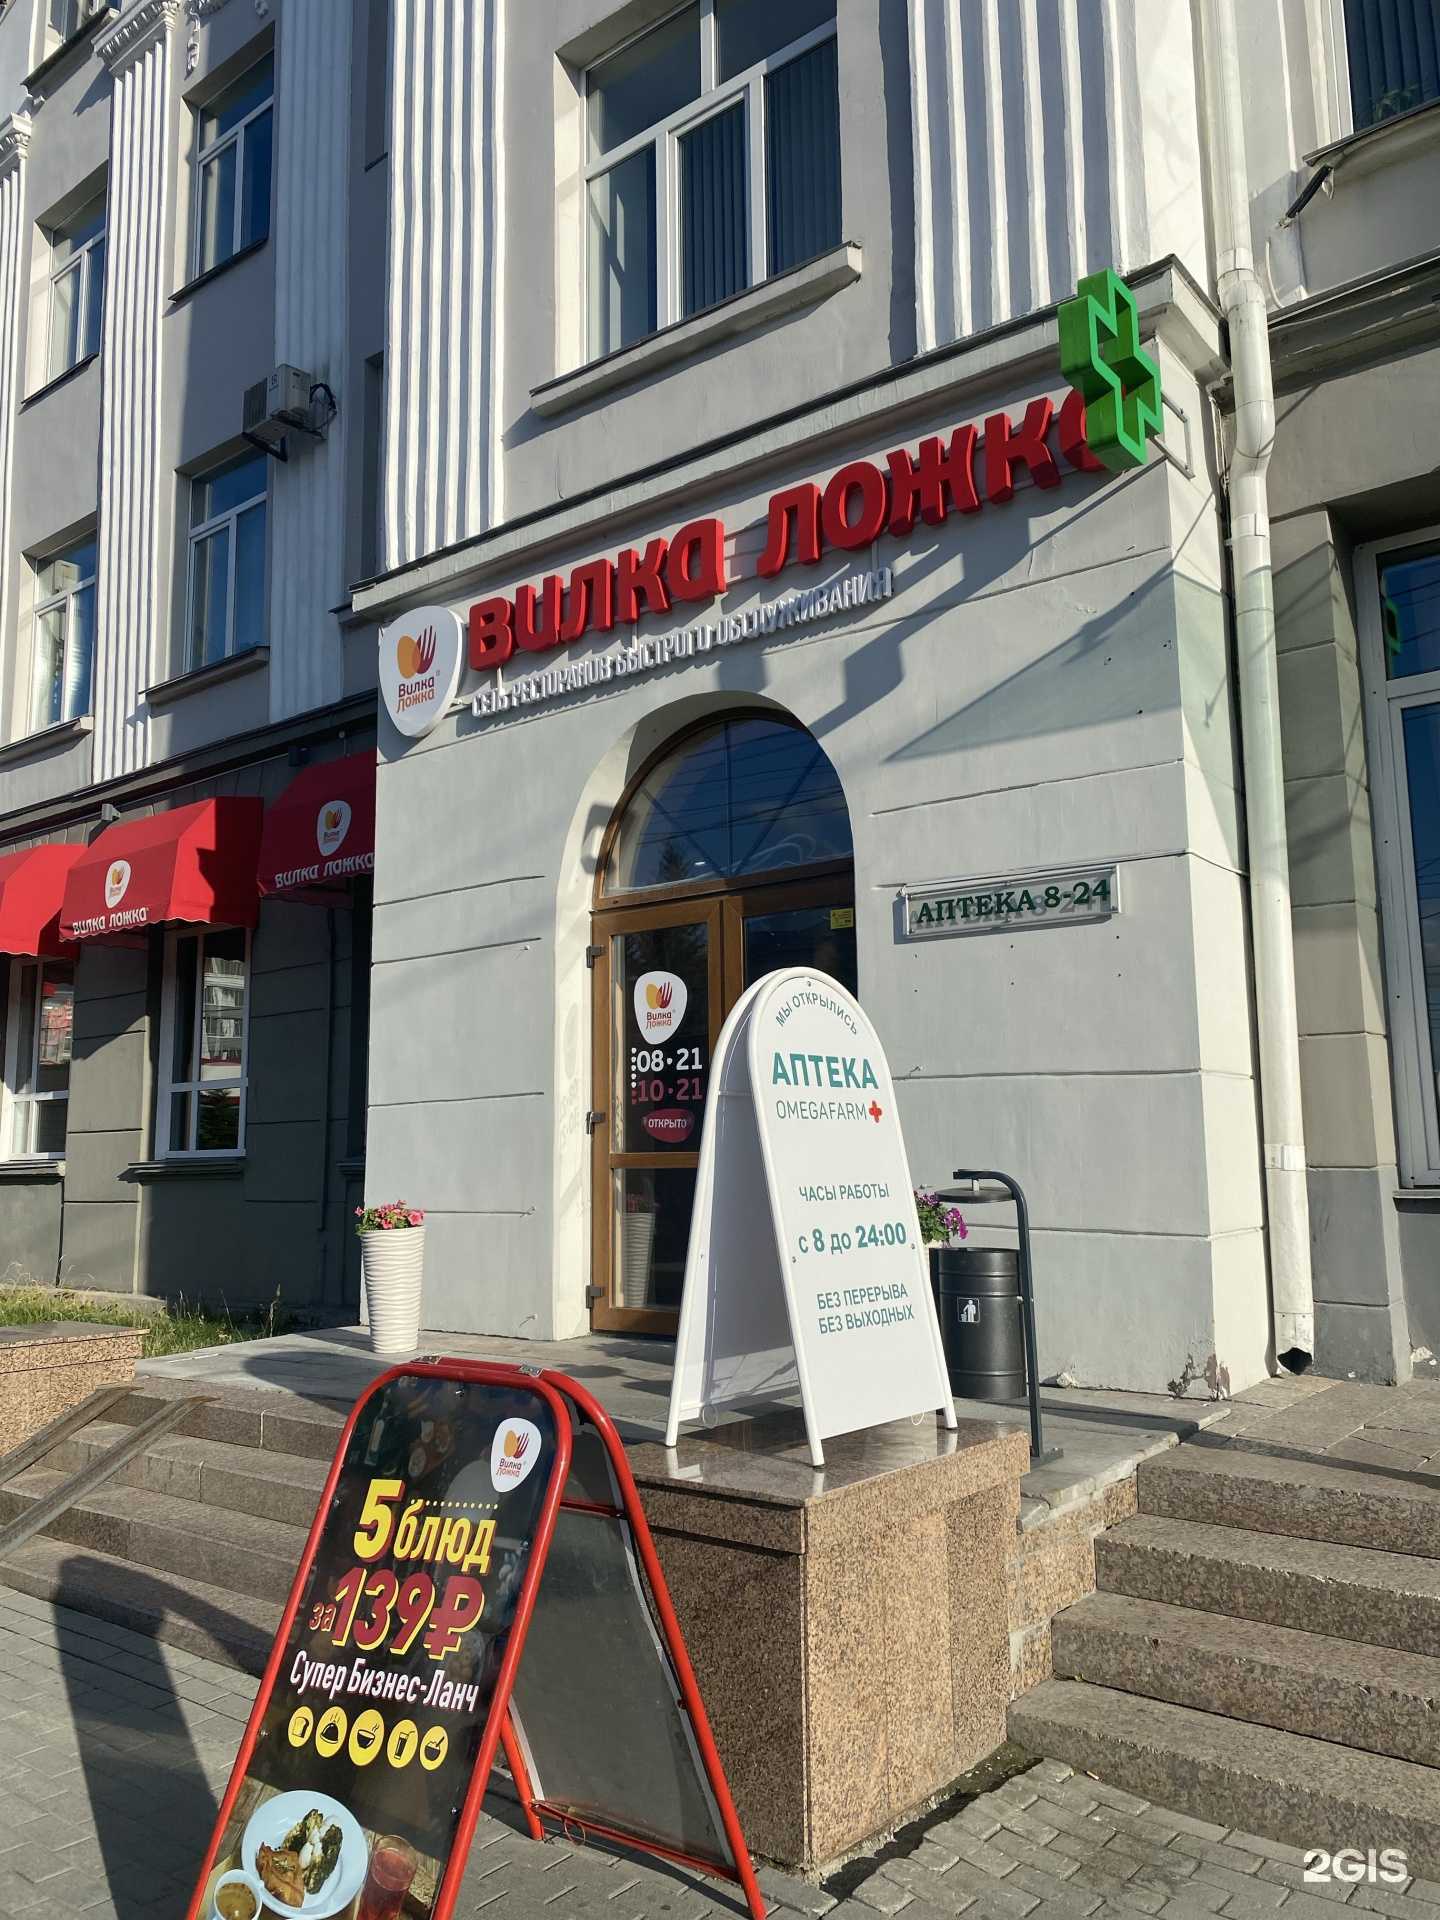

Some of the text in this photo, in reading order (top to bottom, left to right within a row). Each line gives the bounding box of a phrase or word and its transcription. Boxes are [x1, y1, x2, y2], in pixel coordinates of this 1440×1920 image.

[472, 567, 893, 717] СЕТЬ РЕСТОРАНОВ БЫСТРОГО ОБСЛУЖИВАНИЯ
[396, 687, 435, 714] Ложка
[398, 676, 435, 697] Вилка
[916, 879, 1111, 923] АПТЕКА 8-24
[645, 1018, 673, 1030] Ложка
[646, 1011, 673, 1021] Вилка
[775, 990, 859, 1035] МЫ ОТКРЫЛИСЬ
[772, 1051, 879, 1090] АПТЕКА
[648, 1117, 688, 1129] ОТКРЫТО
[776, 1100, 868, 1121] OMEGAFARM
[799, 1183, 890, 1202] ЧАСЫ РАБОТЫ
[812, 1228, 825, 1254] 8
[855, 1222, 907, 1249] 24:00
[816, 1283, 909, 1310] БЕЗ ПЕРЕРЫВА
[818, 1304, 914, 1335] БЕЗ ВЫХОДНЫХ
[354, 1478, 497, 1576] 5 блюд
[309, 1601, 337, 1633] за
[290, 1650, 480, 1712] Супер Бизнес-Ланч
